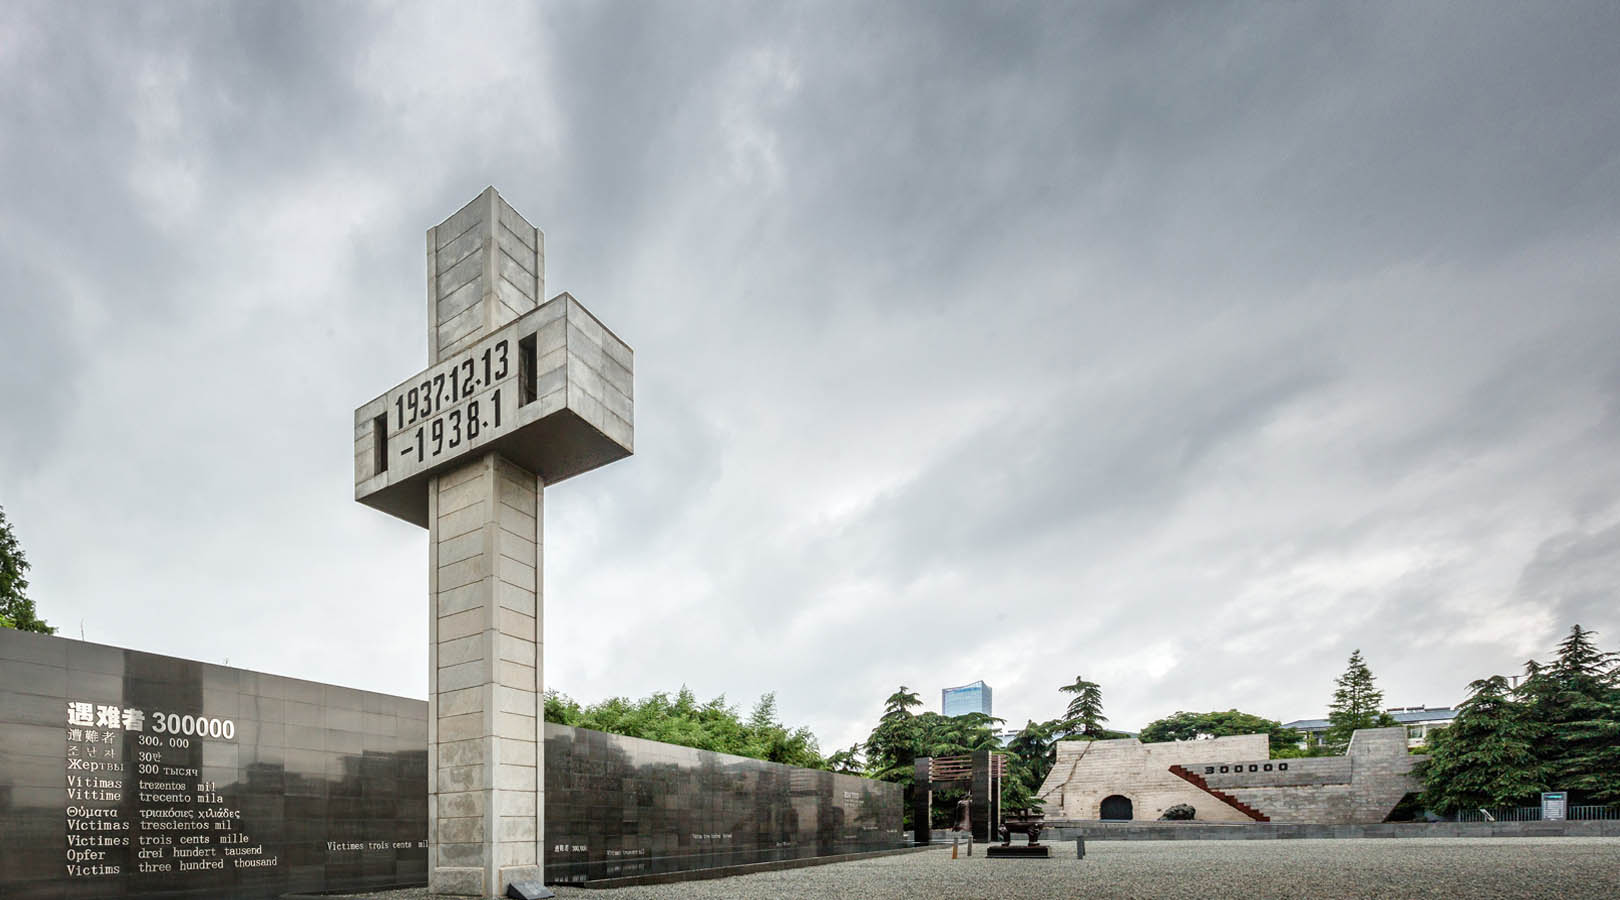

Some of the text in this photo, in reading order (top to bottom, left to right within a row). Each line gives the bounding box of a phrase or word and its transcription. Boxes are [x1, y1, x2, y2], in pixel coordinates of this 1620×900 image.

[395, 339, 509, 430] 1937.12.13
[67, 702, 235, 740] 遇难者 300000
[67, 728, 116, 744] 遭難者
[67, 758, 199, 776] Жертвы 300 тысяч
[1205, 763, 1288, 774] 300000
[139, 779, 186, 791] trezentos
[197, 782, 216, 792] mil
[67, 788, 223, 803] Vittime trecento mila
[140, 820, 210, 830] trescientos
[214, 820, 232, 830] mil
[67, 833, 249, 847] Victimes trois cents mille
[327, 839, 429, 851] Victimes trois cents mil
[66, 845, 263, 863] Opfer drei hundert tausend
[66, 856, 278, 876] Victims three hundred thousand
